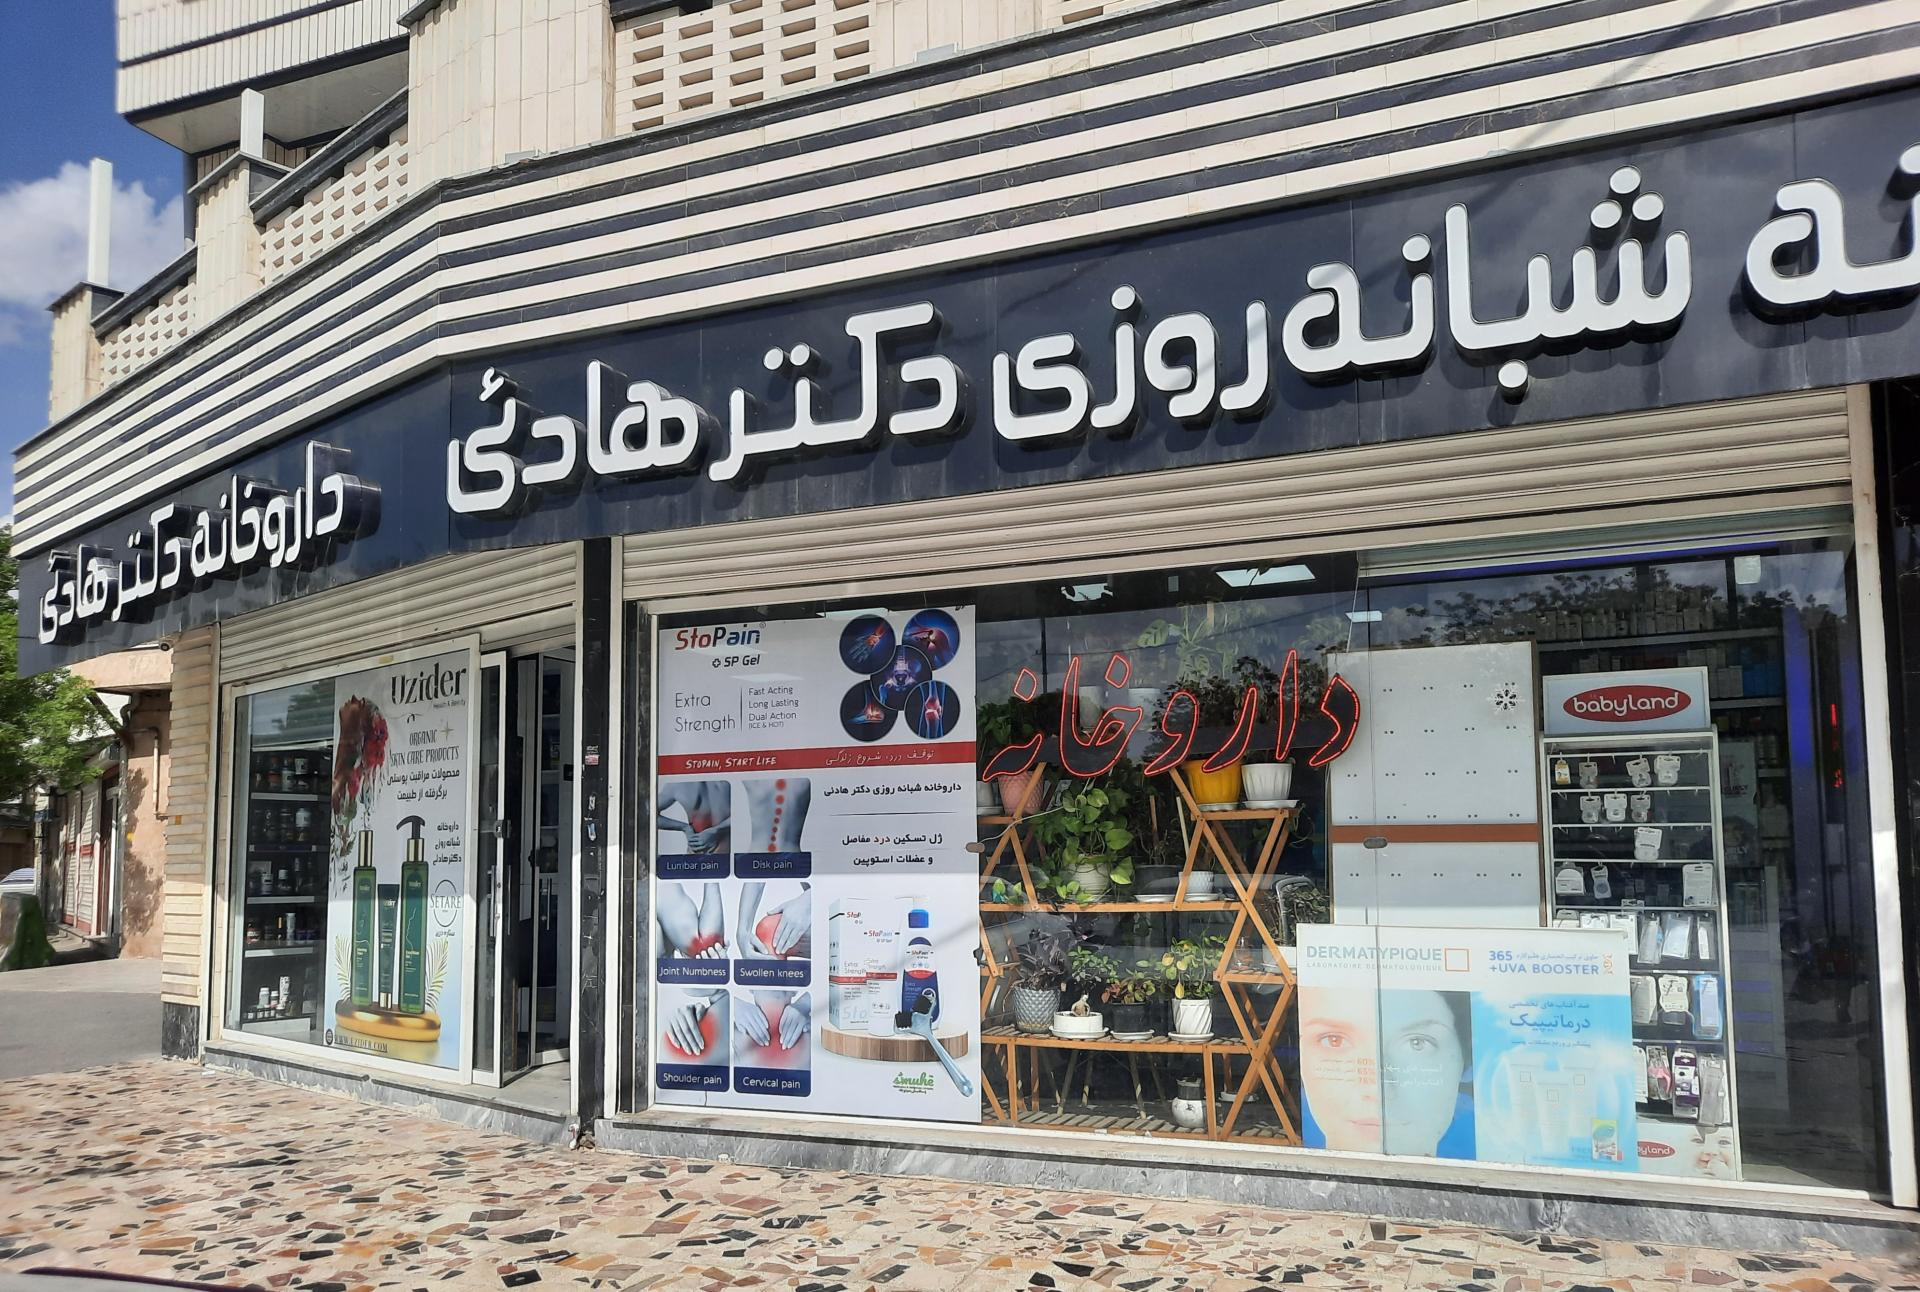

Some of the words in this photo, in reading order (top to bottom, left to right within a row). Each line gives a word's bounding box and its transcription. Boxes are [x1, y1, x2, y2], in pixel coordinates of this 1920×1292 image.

[1282, 165, 1692, 390] شبانه
[992, 285, 1269, 440] روزی
[708, 301, 958, 482] دکتر
[191, 440, 345, 578] داروخانه
[111, 503, 182, 622] دکتر
[675, 624, 761, 650] StoPain
[724, 656, 739, 667] SP
[742, 654, 761, 666] Gel
[391, 663, 467, 704] Uzider
[748, 688, 765, 696] Fast
[767, 686, 793, 695] Acting
[675, 693, 711, 708] Extra
[748, 701, 769, 709] Long
[771, 699, 799, 707] Lasting
[1573, 692, 1679, 716] babyland
[748, 713, 768, 721] Dual
[770, 711, 797, 720] Action
[982, 649, 1360, 782] داروخانه
[675, 714, 736, 733] Strength
[409, 729, 437, 746] ORGANIC
[407, 749, 424, 766] CARE
[426, 746, 460, 764] PRODUCTS
[856, 751, 882, 764] شروع
[387, 774, 408, 786] پوستی
[410, 770, 429, 783] مراقبت
[432, 768, 460, 781] محصولات
[425, 784, 448, 800] برگرفته
[851, 785, 871, 796] دکتر
[872, 785, 895, 795] روزی
[897, 783, 922, 794] شبانه
[924, 782, 962, 794] داروخانه
[397, 788, 416, 802] طبیعت
[842, 834, 871, 845] مفاصل
[874, 836, 890, 845] درد
[893, 834, 926, 845] تسکین
[929, 833, 943, 844] ژل
[753, 860, 770, 869] Disk
[774, 859, 793, 870] pain
[853, 855, 893, 867] استوپین
[896, 854, 925, 863] عضلات
[666, 861, 698, 870] Lumbar
[701, 861, 719, 871] pain
[430, 893, 461, 909] SETARE
[1306, 945, 1442, 961] DERMATYPIQUE
[1489, 950, 1513, 961] 365
[659, 966, 679, 976] Joint
[682, 967, 726, 976] Numbness
[740, 968, 775, 976] Swollen
[777, 968, 804, 977] knees
[1532, 964, 1599, 975] BOOSTER
[663, 1072, 700, 1083] Shoulder
[703, 1075, 722, 1085] pain
[743, 1077, 778, 1087] Cervical
[781, 1079, 800, 1090] pain
